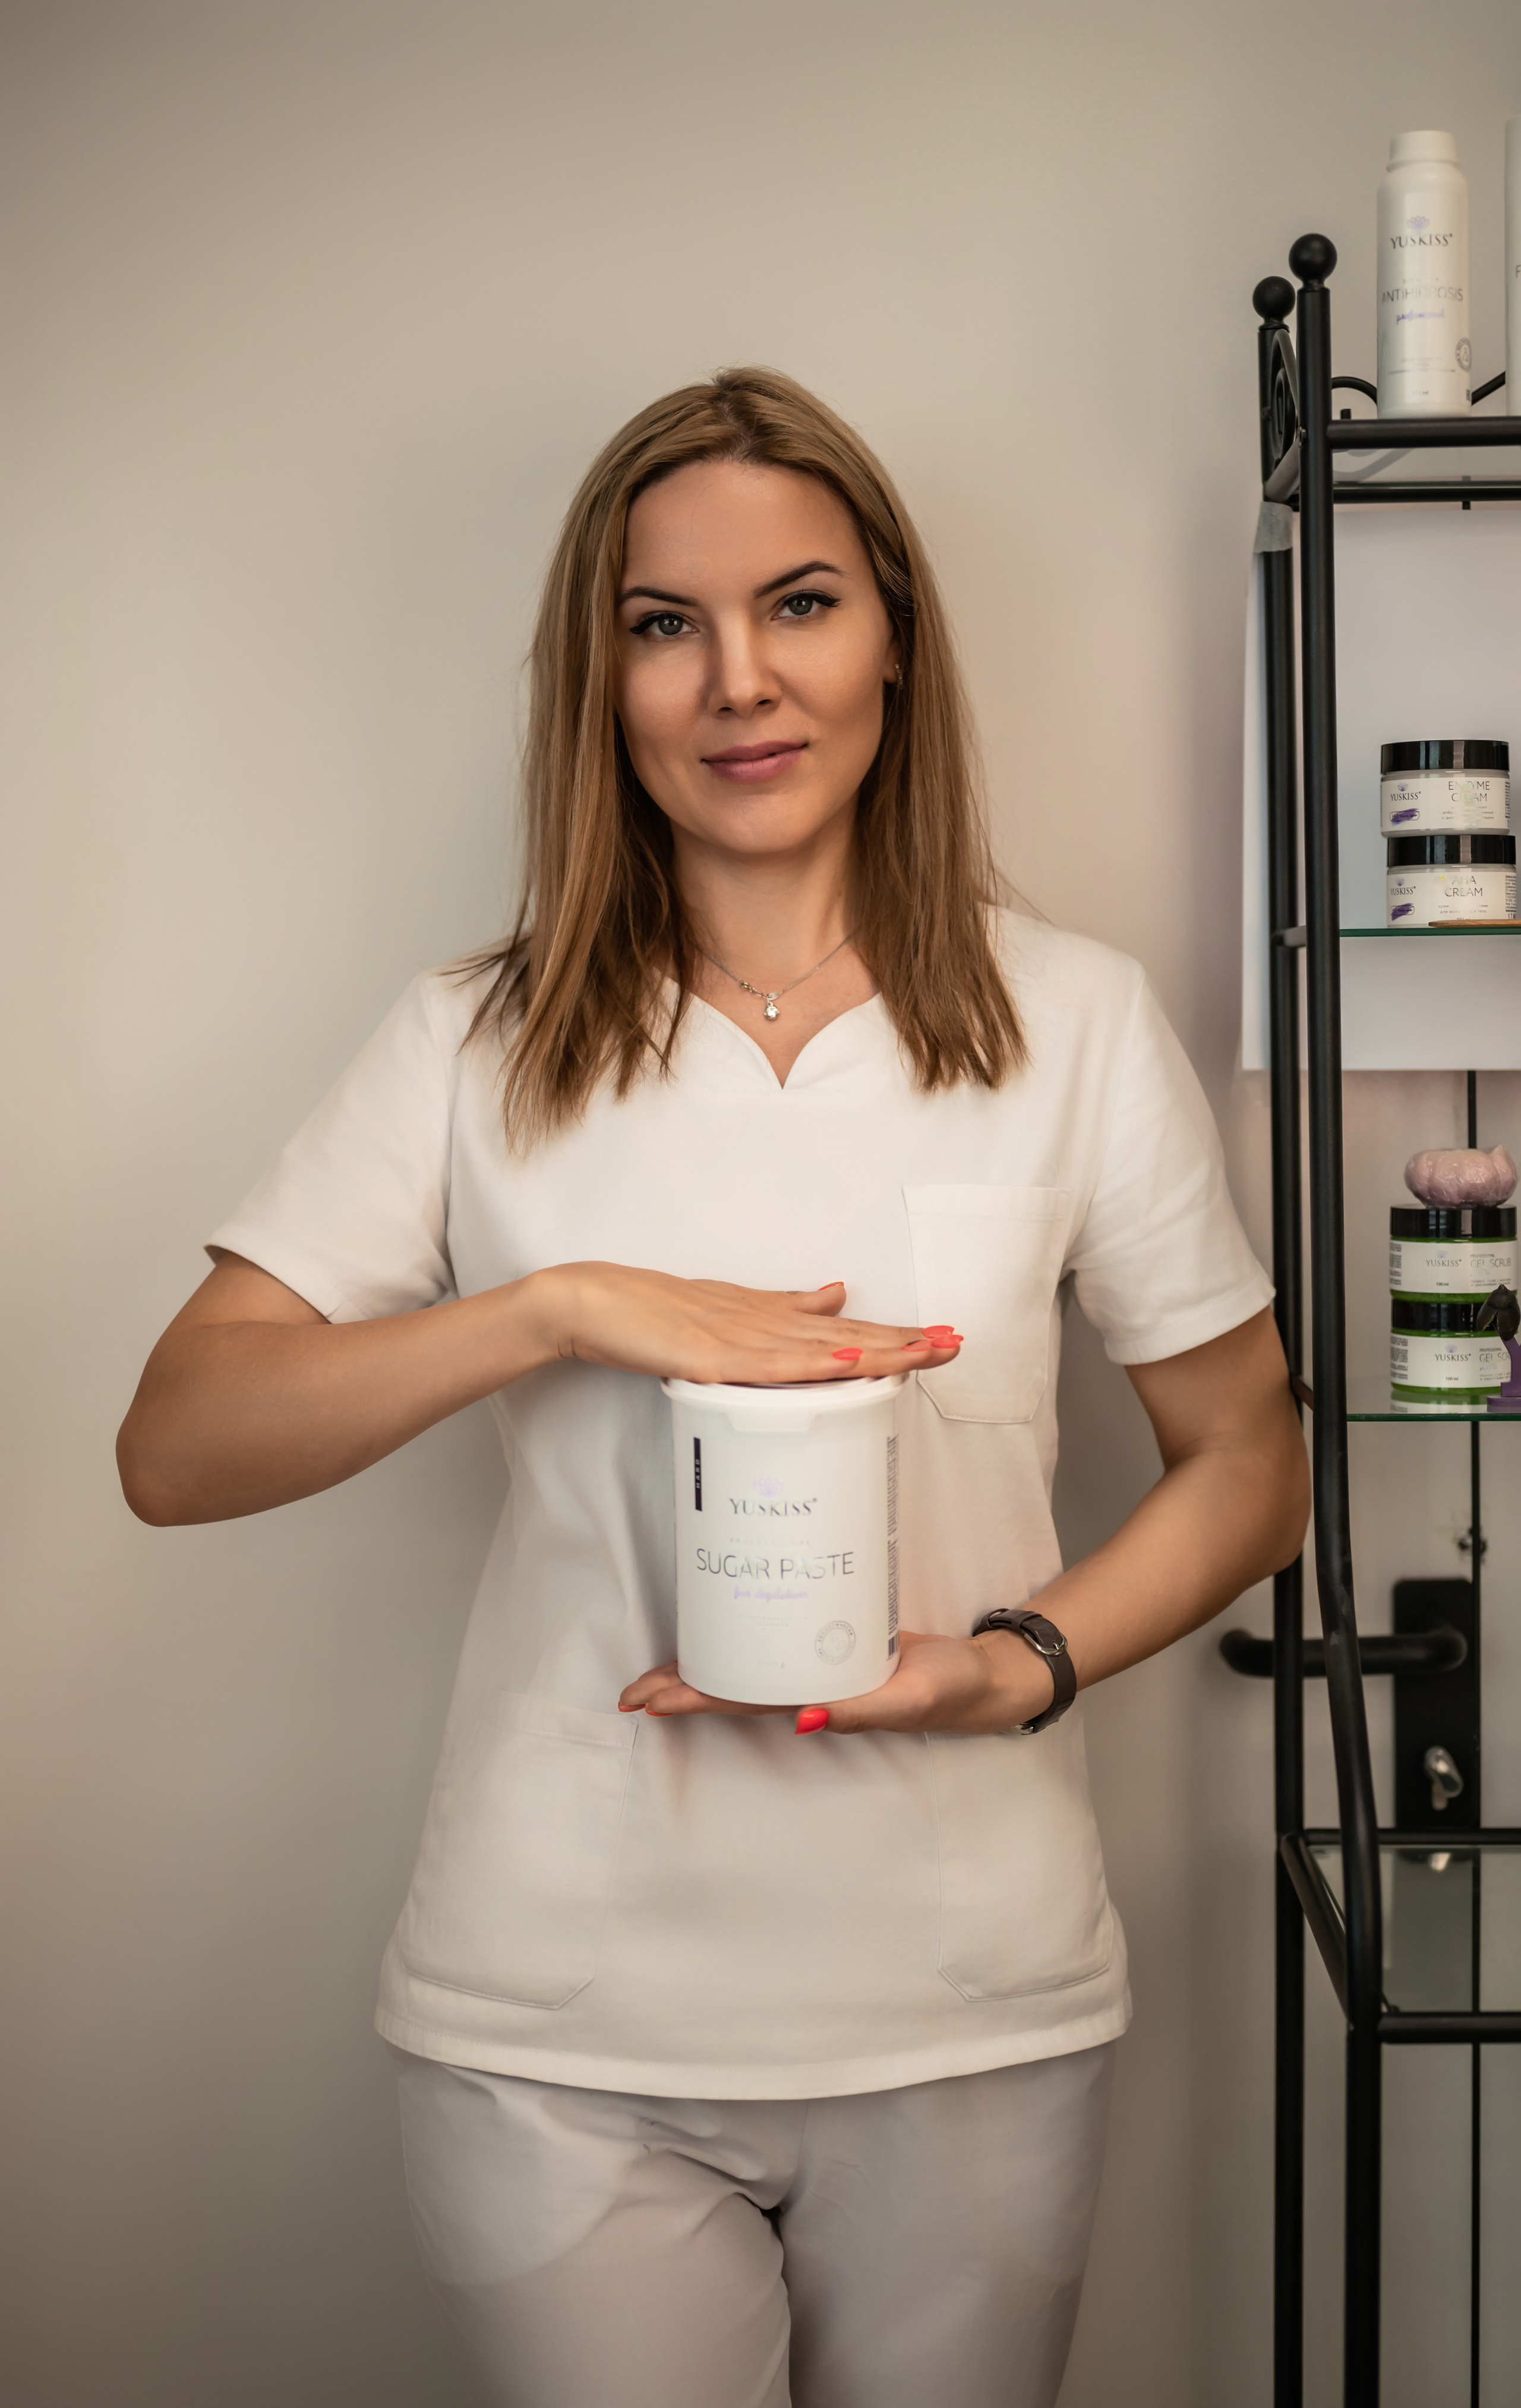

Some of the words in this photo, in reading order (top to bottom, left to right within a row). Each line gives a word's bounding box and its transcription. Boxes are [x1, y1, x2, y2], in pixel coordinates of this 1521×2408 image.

[1444, 887, 1483, 897] CREAM
[1490, 1258, 1511, 1268] SCRUB
[696, 1548, 771, 1580] SUGAR
[780, 1551, 855, 1580] PASTE
